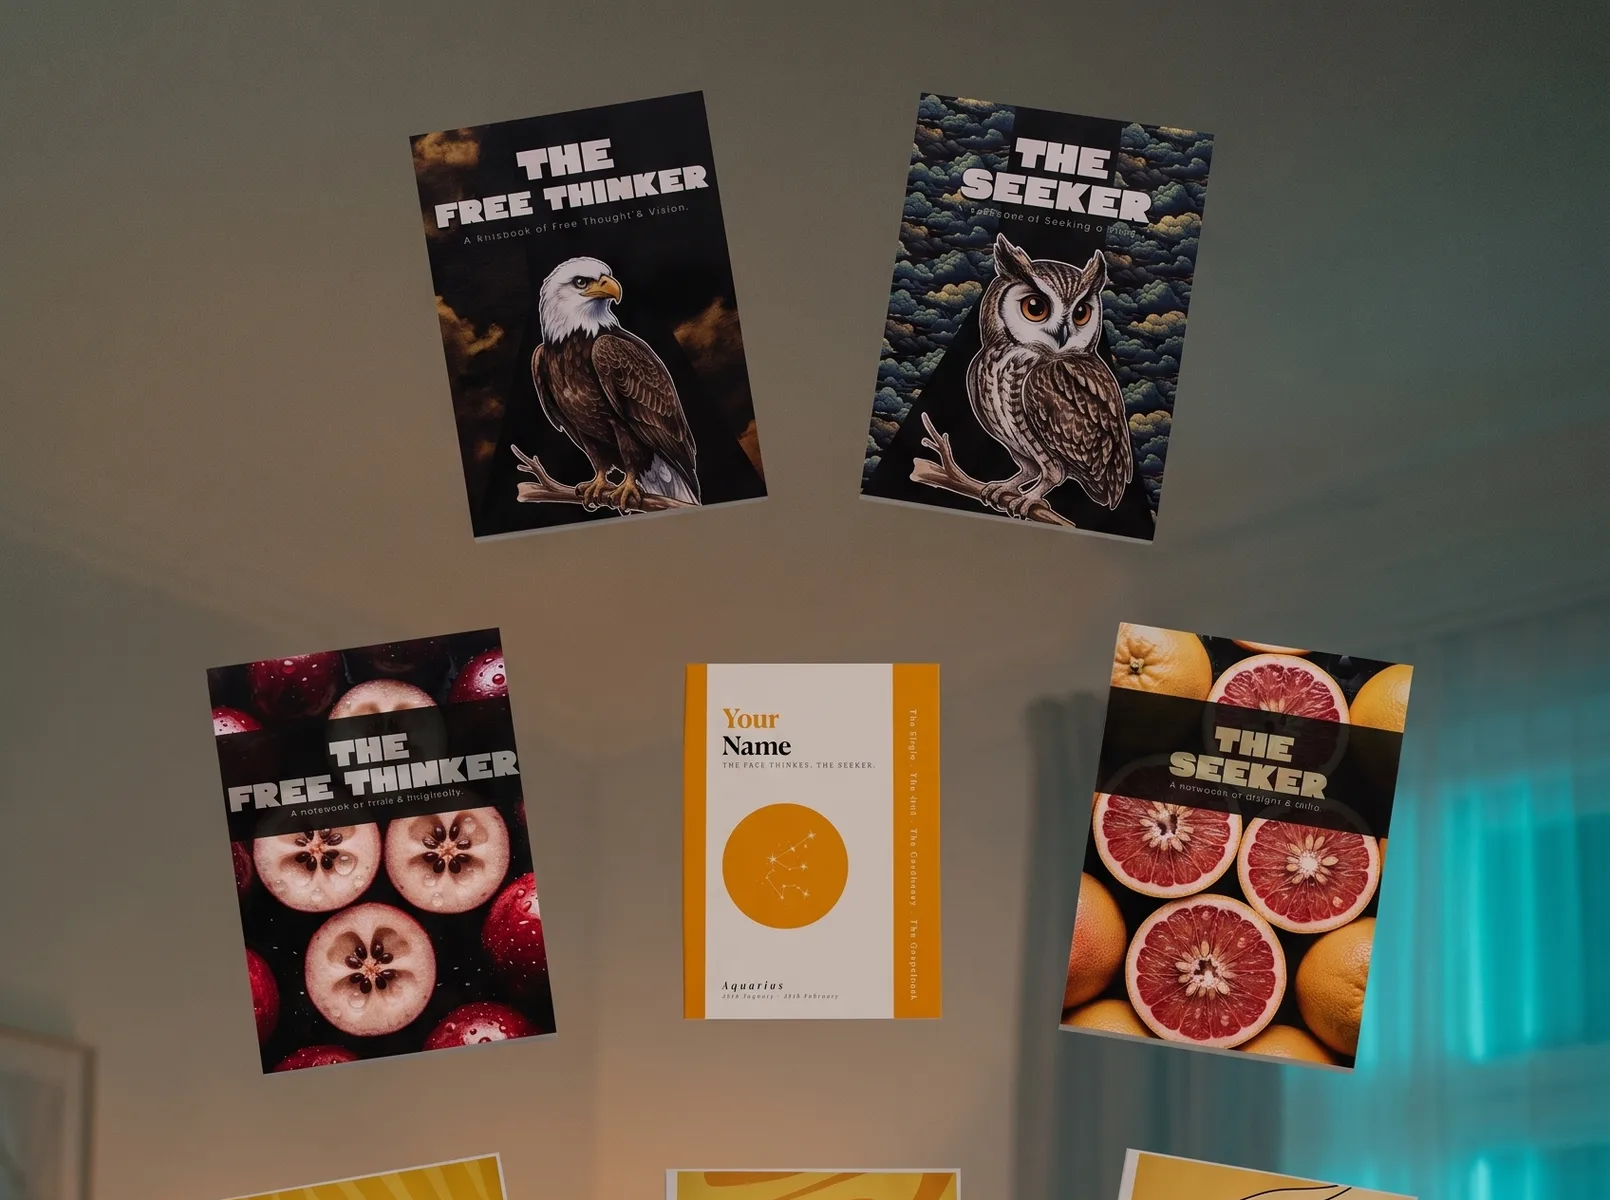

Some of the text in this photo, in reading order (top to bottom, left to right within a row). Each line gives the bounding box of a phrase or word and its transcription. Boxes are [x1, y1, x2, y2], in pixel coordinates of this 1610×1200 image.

[516, 138, 615, 180] THE
[1015, 137, 1111, 180] THE
[434, 165, 709, 228] FREE THINKER
[960, 168, 1152, 224] SEEKER
[463, 236, 472, 245] A
[535, 223, 547, 234] of
[552, 219, 578, 232] Free
[1044, 216, 1092, 233] Seeking
[723, 708, 780, 729] Your
[329, 732, 410, 768] THE
[722, 735, 792, 756] Name
[1214, 726, 1295, 763] THE
[816, 761, 834, 769] THE
[1169, 751, 1328, 800] SEEKER
[227, 750, 521, 813] FREE THINKER
[1169, 781, 1177, 789] A
[290, 809, 298, 818] A
[397, 795, 404, 804] &
[722, 981, 784, 993] Aquarius
